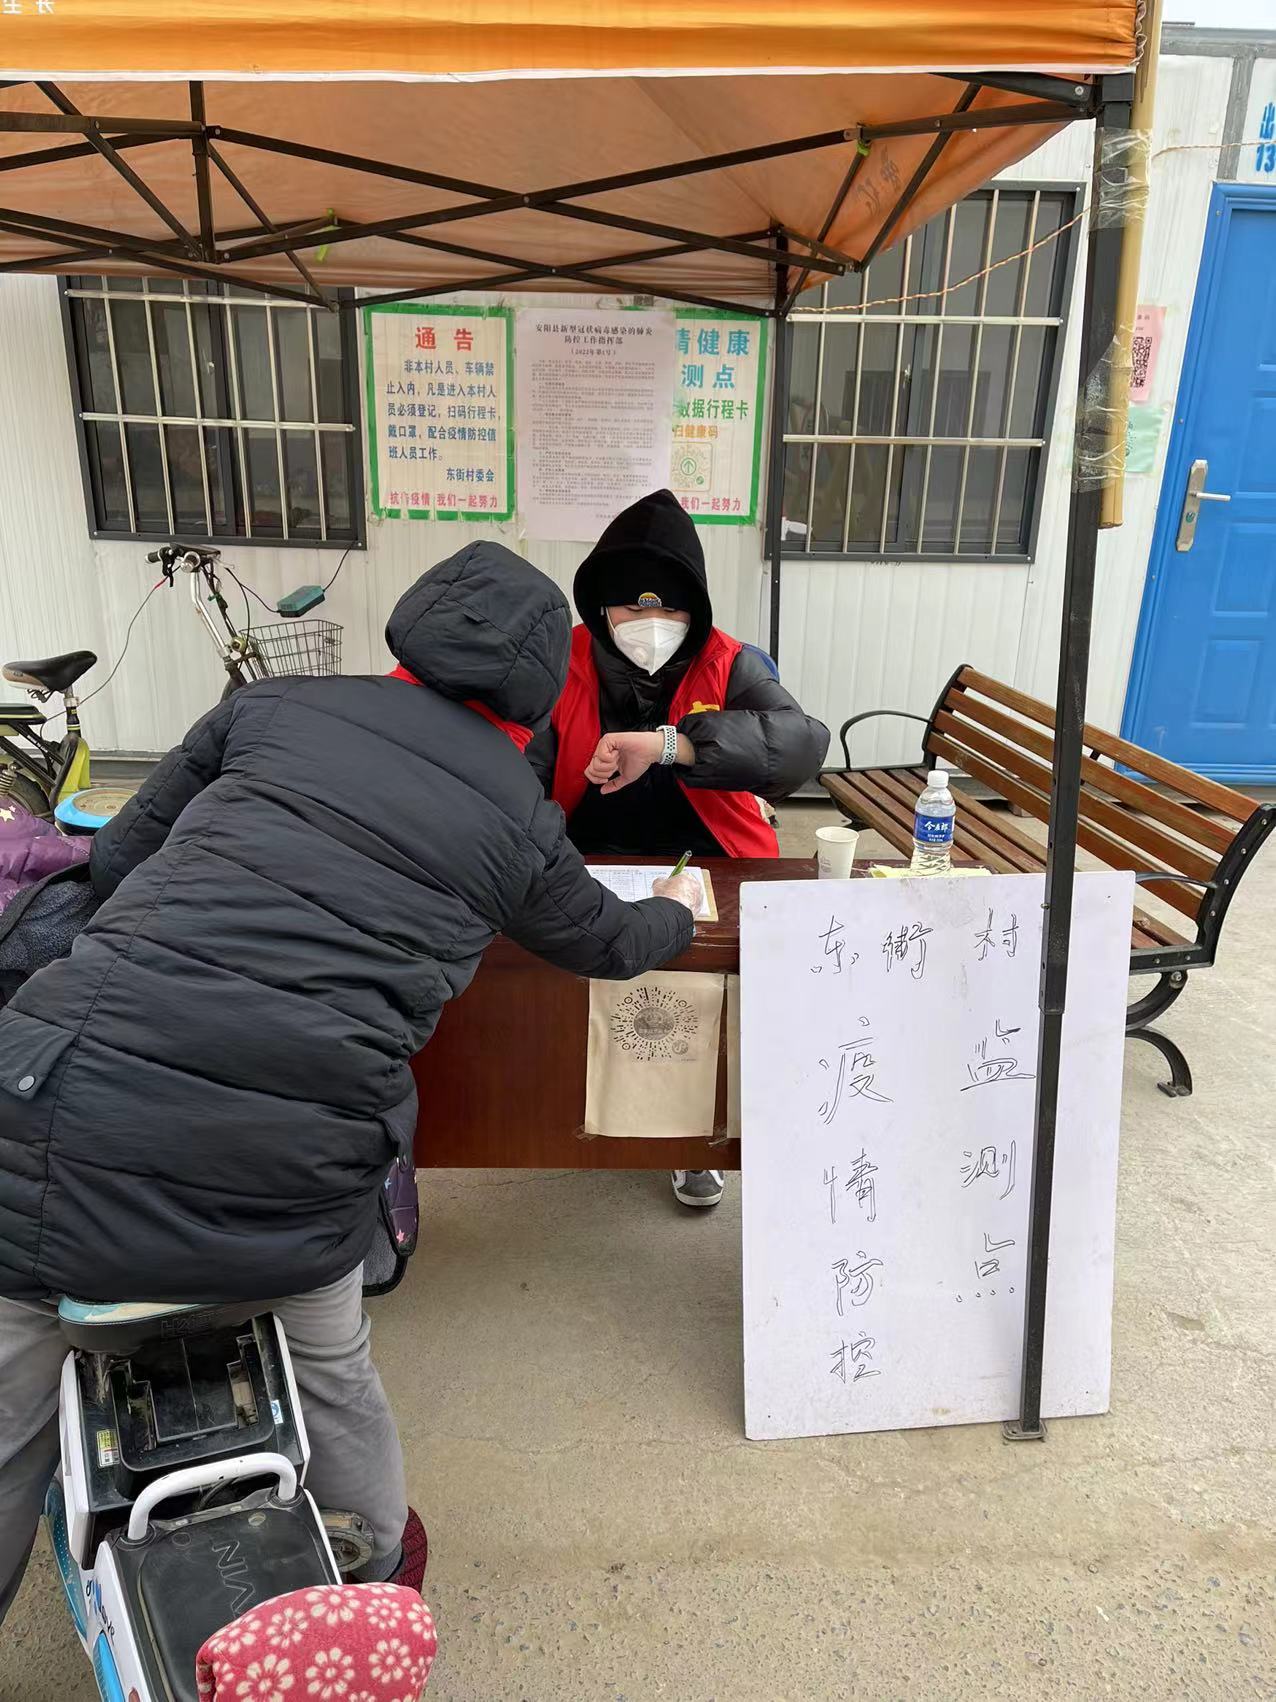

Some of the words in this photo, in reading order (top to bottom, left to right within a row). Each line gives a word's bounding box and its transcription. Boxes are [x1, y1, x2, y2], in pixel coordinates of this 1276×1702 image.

[415, 327, 474, 351] 通告
[404, 359, 494, 376] 非本村人员、车辆禁
[681, 364, 735, 388] 测点
[446, 467, 495, 482] 东街村委会
[436, 493, 498, 508] 我们一起努力
[955, 1019, 1036, 1304] 监测点
[817, 1016, 893, 1384] 疫情防控
